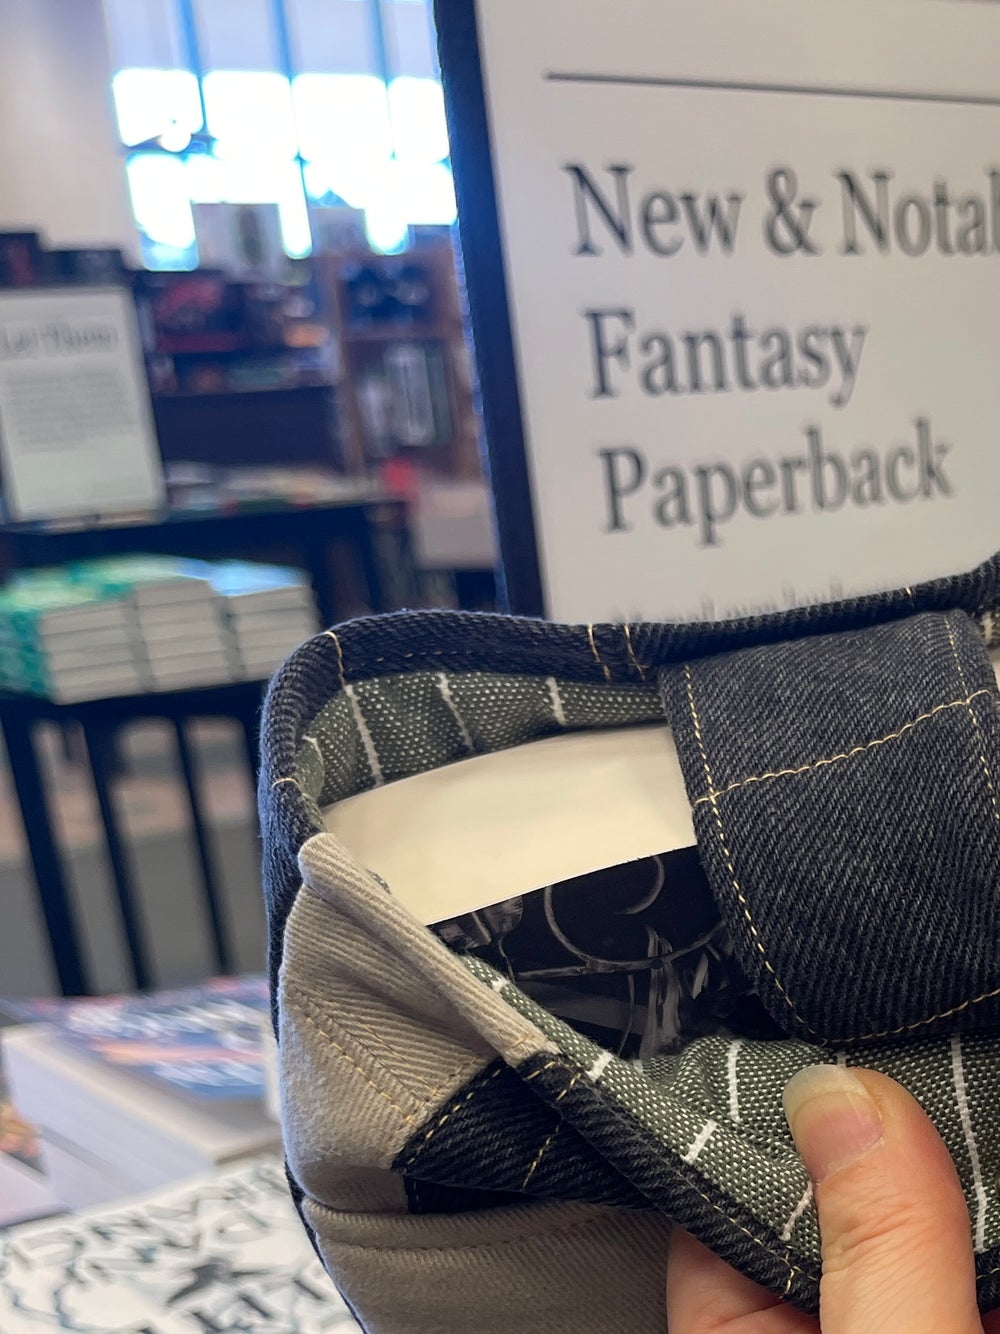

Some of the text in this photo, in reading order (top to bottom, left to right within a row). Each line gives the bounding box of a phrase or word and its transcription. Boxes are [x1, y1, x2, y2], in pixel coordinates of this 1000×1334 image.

[565, 163, 744, 257] New
[762, 166, 823, 258] &
[582, 308, 868, 406] Fantasy
[597, 415, 953, 547] Paperback
